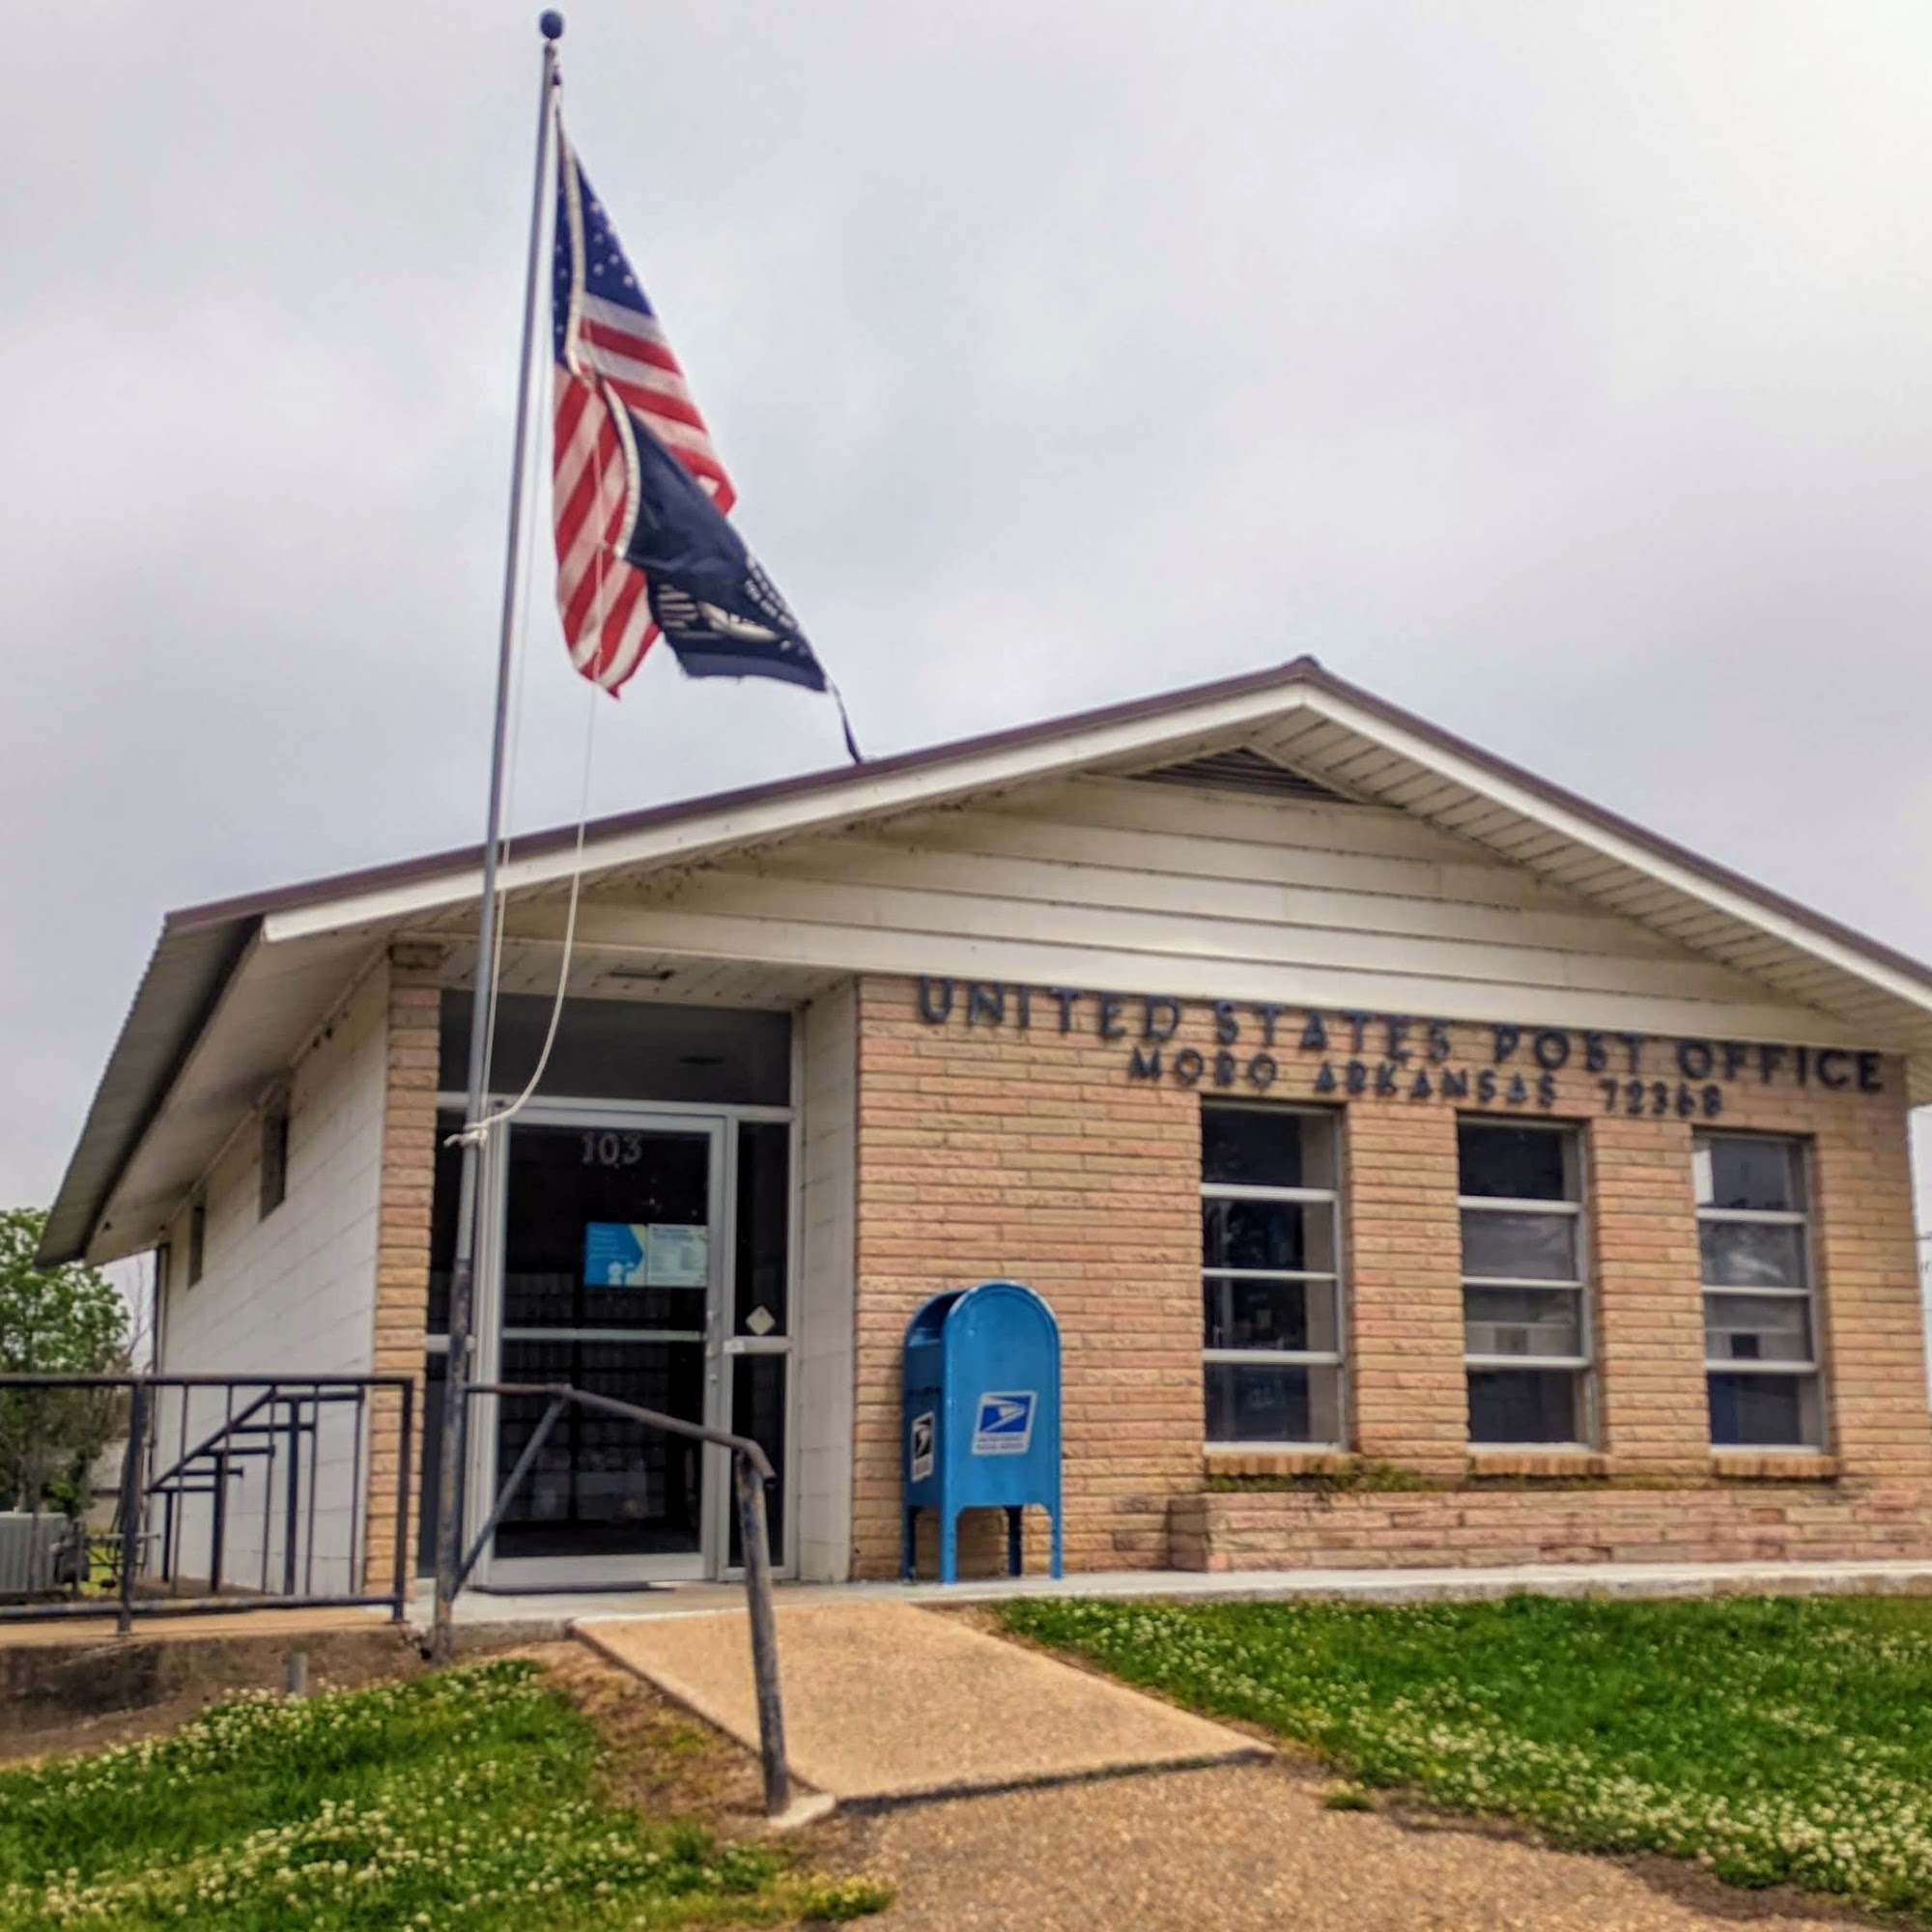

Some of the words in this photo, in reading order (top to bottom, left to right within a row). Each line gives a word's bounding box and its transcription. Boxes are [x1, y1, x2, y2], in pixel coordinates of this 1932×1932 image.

[917, 975, 1182, 1042] UNITED
[1213, 999, 1452, 1064] STATES
[1493, 1022, 1645, 1074] POST
[1676, 1037, 1885, 1093] OFFICE
[1128, 1045, 1278, 1088] MORO
[1314, 1060, 1558, 1108] ARKANSAS
[1597, 1077, 1725, 1118] 72368
[582, 1131, 643, 1165] 103
